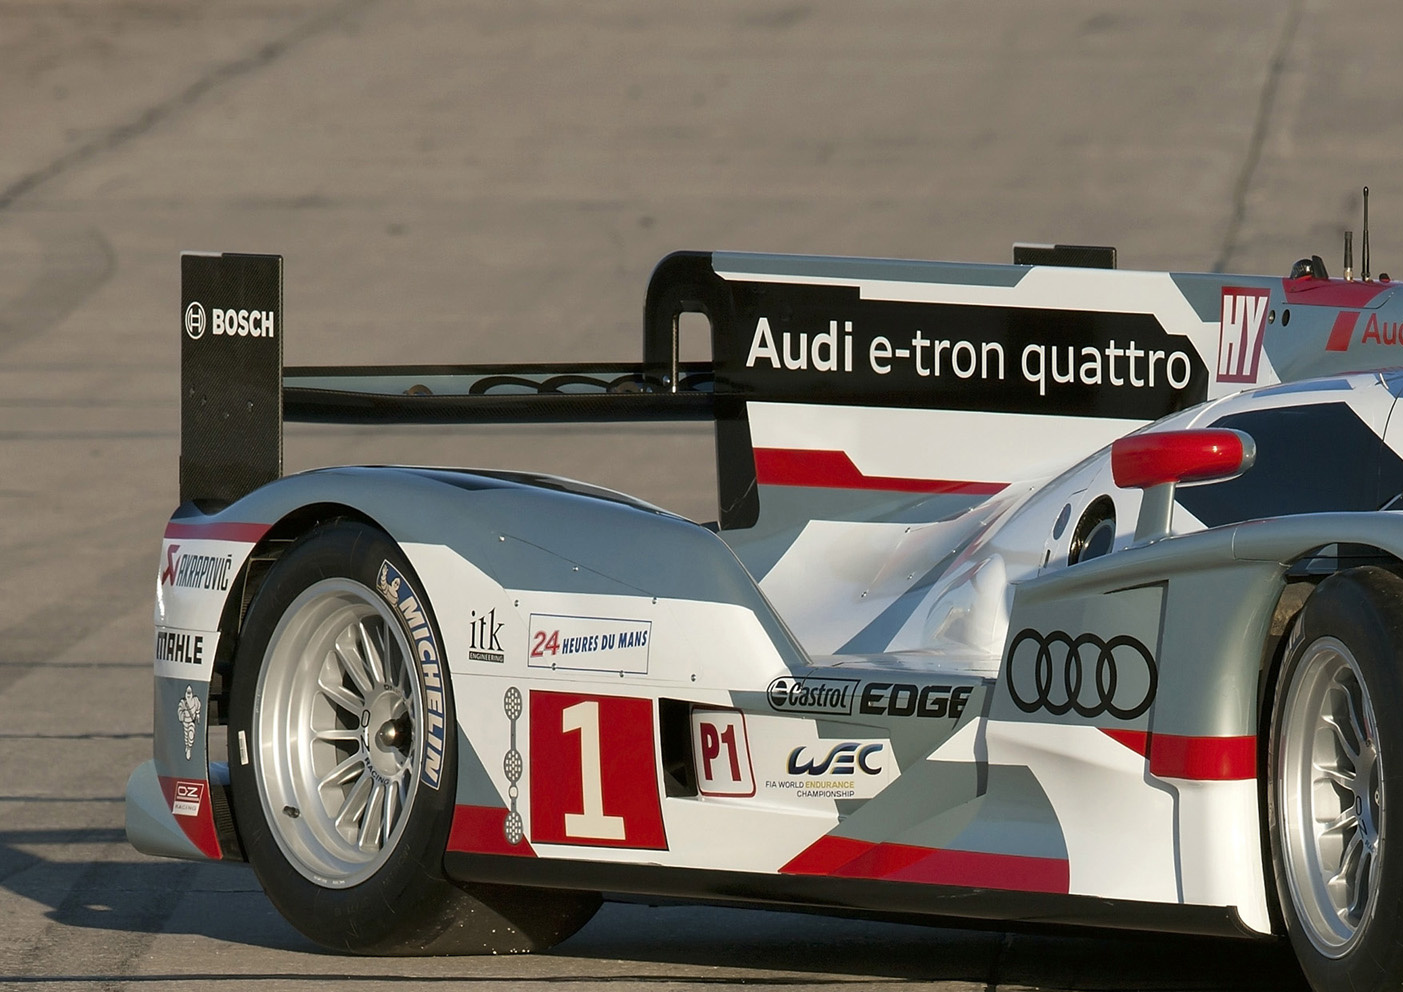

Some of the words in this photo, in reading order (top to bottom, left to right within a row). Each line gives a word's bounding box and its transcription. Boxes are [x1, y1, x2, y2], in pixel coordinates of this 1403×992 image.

[211, 308, 275, 338] BOSCH
[1218, 294, 1267, 377] HY
[745, 316, 854, 373] Audi
[868, 329, 1005, 380] e-tron
[1020, 338, 1192, 397] quattro
[469, 607, 505, 651] itk
[529, 629, 560, 658] 24
[561, 634, 599, 655] HEURES
[601, 633, 616, 650] DU
[617, 630, 648, 649] MANS
[156, 631, 204, 665] MAHLE
[469, 652, 504, 662] ENGINEERING
[399, 595, 445, 784] MICHELIN
[787, 680, 850, 709] Castrol
[859, 682, 975, 719] EDGE
[561, 699, 627, 842] 1
[698, 721, 743, 783] P1
[786, 741, 884, 777] WEC
[765, 780, 777, 789] FIA
[778, 781, 804, 789] WORLD
[805, 780, 855, 789] ENDURANCE
[796, 789, 855, 798] CHAMPIONSHIP
